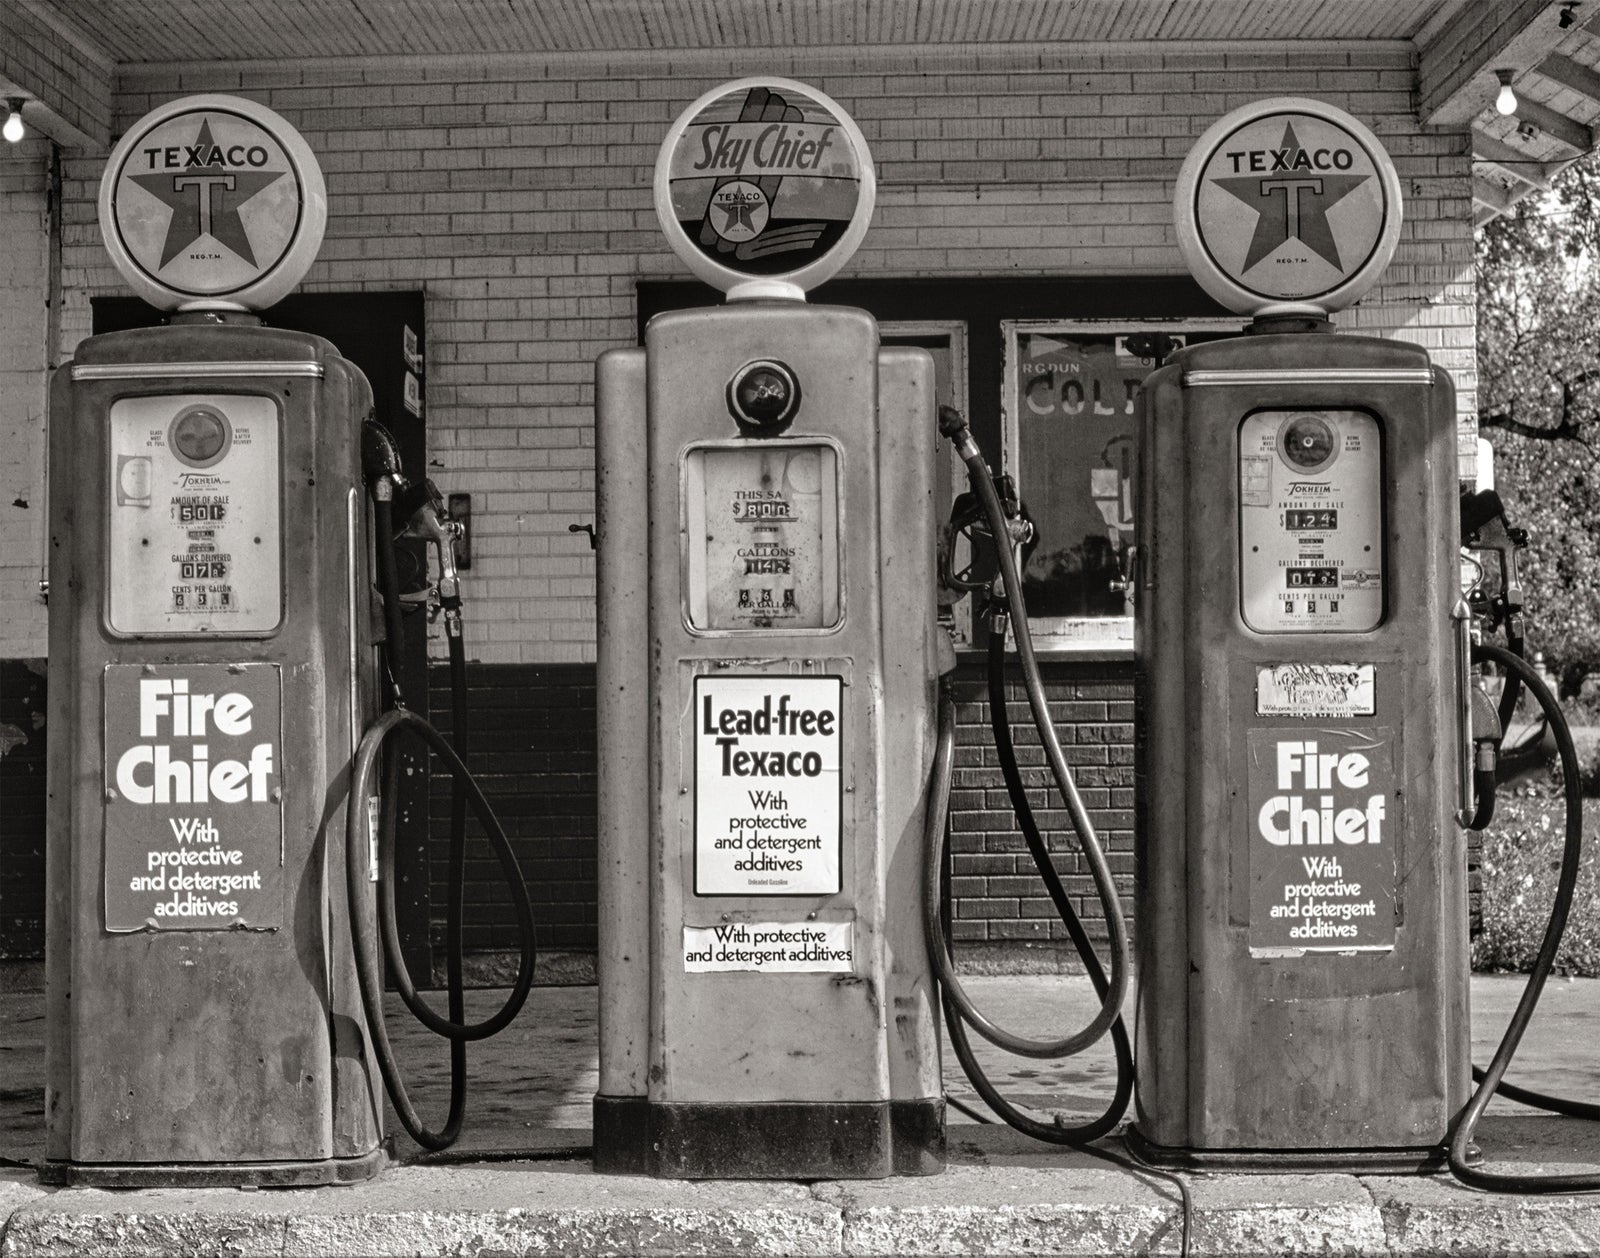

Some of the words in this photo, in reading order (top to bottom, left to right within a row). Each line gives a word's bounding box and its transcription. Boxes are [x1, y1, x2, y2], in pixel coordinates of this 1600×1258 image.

[143, 145, 269, 169] TEXACO
[694, 125, 752, 174] Sky
[753, 124, 834, 170] Chief
[1226, 148, 1353, 173] TEXACO
[718, 192, 761, 202] TEXACO
[734, 490, 762, 499] THIS
[1288, 482, 1332, 496] TOKHEIM
[171, 496, 200, 505] AMOUNT
[202, 496, 210, 504] OF
[214, 496, 230, 504] SALE
[733, 501, 740, 515] $
[737, 548, 796, 557] GALLONS
[140, 679, 253, 737] Fire
[703, 694, 835, 736] Lead-free
[715, 737, 823, 777] Texaco
[1277, 741, 1370, 790] Fire
[116, 743, 273, 804] Chief
[748, 790, 788, 810] With
[169, 818, 219, 844] With
[729, 813, 807, 833] protective
[1258, 794, 1385, 846] Chief
[714, 830, 743, 850] and
[746, 830, 821, 854] detergent
[148, 846, 243, 871] protective
[734, 851, 803, 872] additives
[1302, 857, 1342, 878] With
[130, 866, 166, 891] and
[169, 866, 261, 894] detergent
[1285, 880, 1361, 901] protective
[154, 892, 238, 916] additives
[1270, 898, 1298, 917] and
[1301, 898, 1375, 919] detergent
[714, 925, 750, 944] With
[754, 929, 826, 947] protective
[1289, 918, 1358, 938] additives
[686, 944, 712, 962] and
[716, 944, 786, 965] detergent
[789, 943, 853, 962] additives
